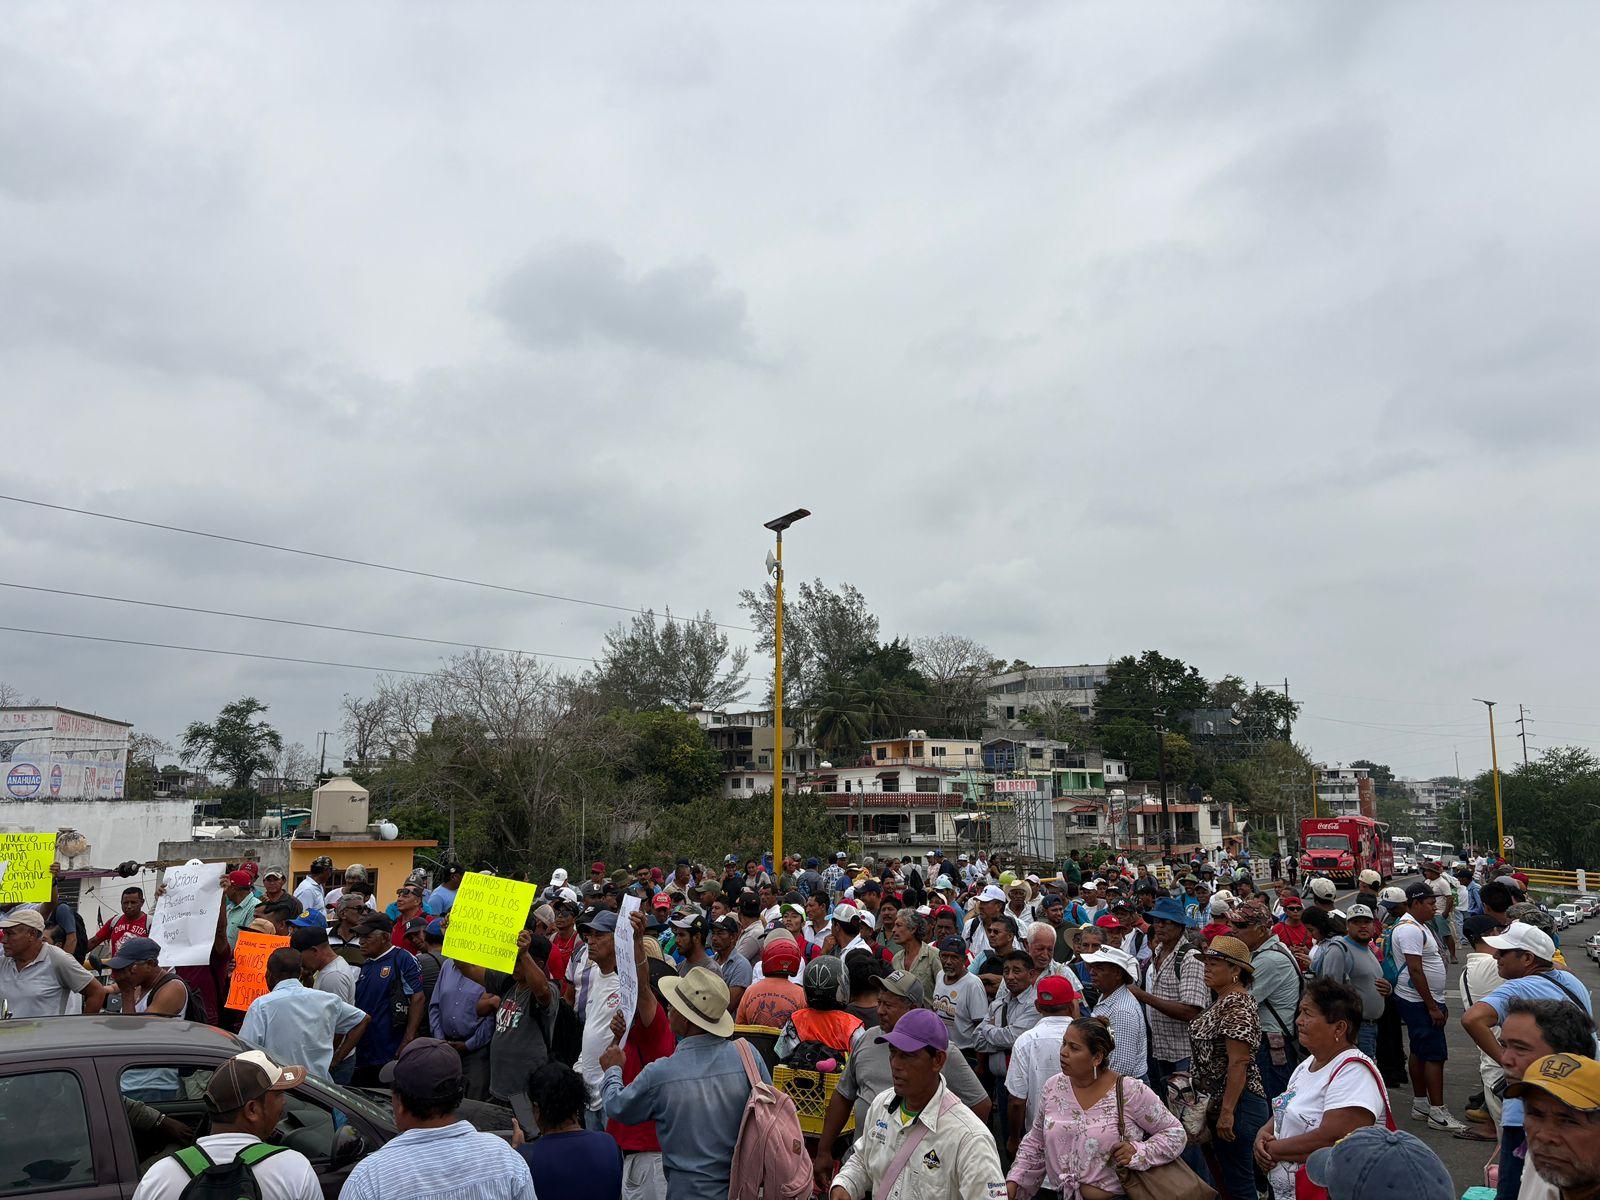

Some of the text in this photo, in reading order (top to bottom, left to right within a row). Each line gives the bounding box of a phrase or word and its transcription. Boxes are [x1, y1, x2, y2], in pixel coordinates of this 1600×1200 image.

[13, 714, 27, 723] DE
[7, 775, 41, 785] ANAHUAC
[996, 780, 1037, 791] EN RENTA
[504, 881, 516, 894] EL
[488, 911, 515, 929] PESOS
